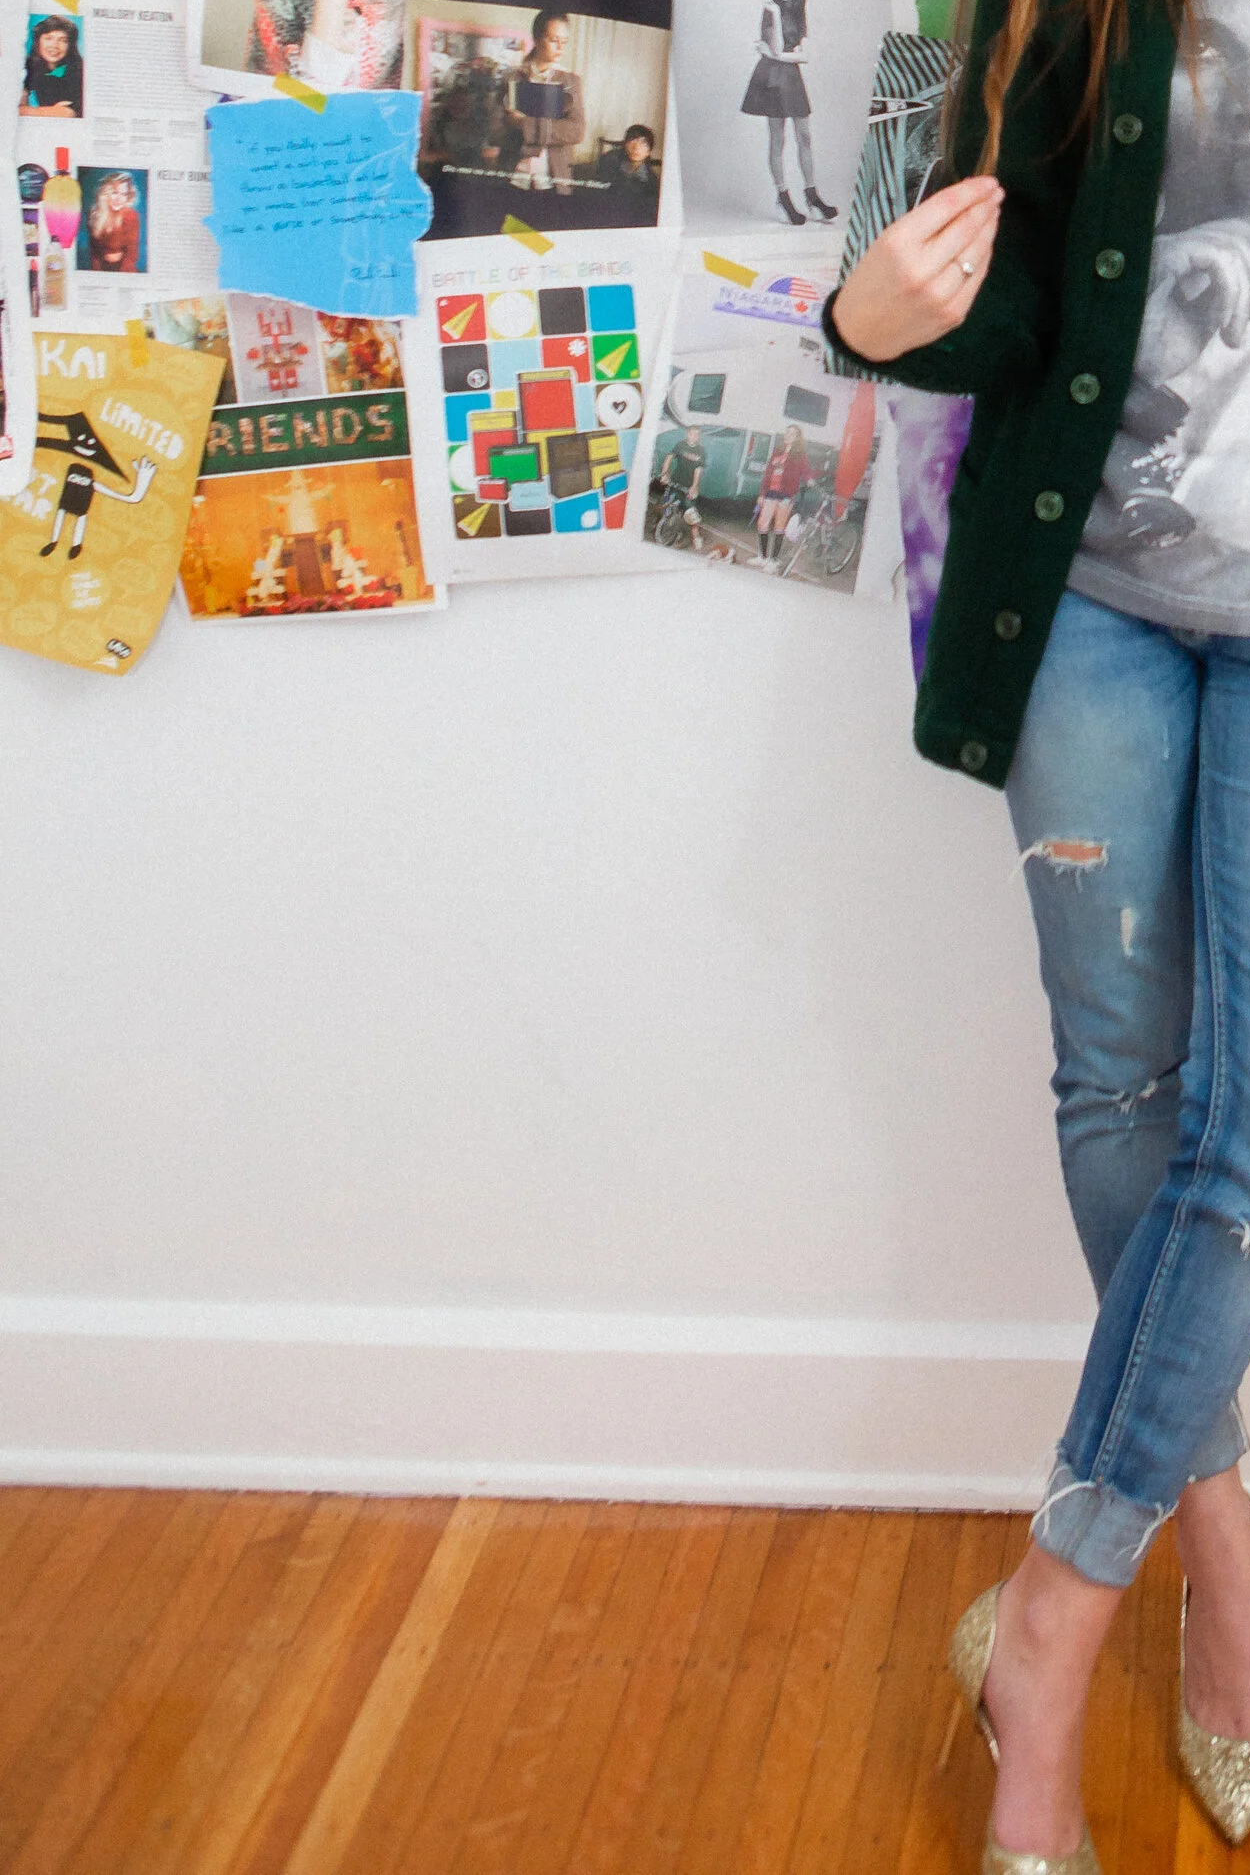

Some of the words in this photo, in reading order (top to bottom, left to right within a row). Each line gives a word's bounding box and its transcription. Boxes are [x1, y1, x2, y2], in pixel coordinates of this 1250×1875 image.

[432, 269, 499, 287] BATTLE
[507, 266, 530, 282] OF
[538, 263, 572, 279] THE
[577, 260, 633, 278] BANDS
